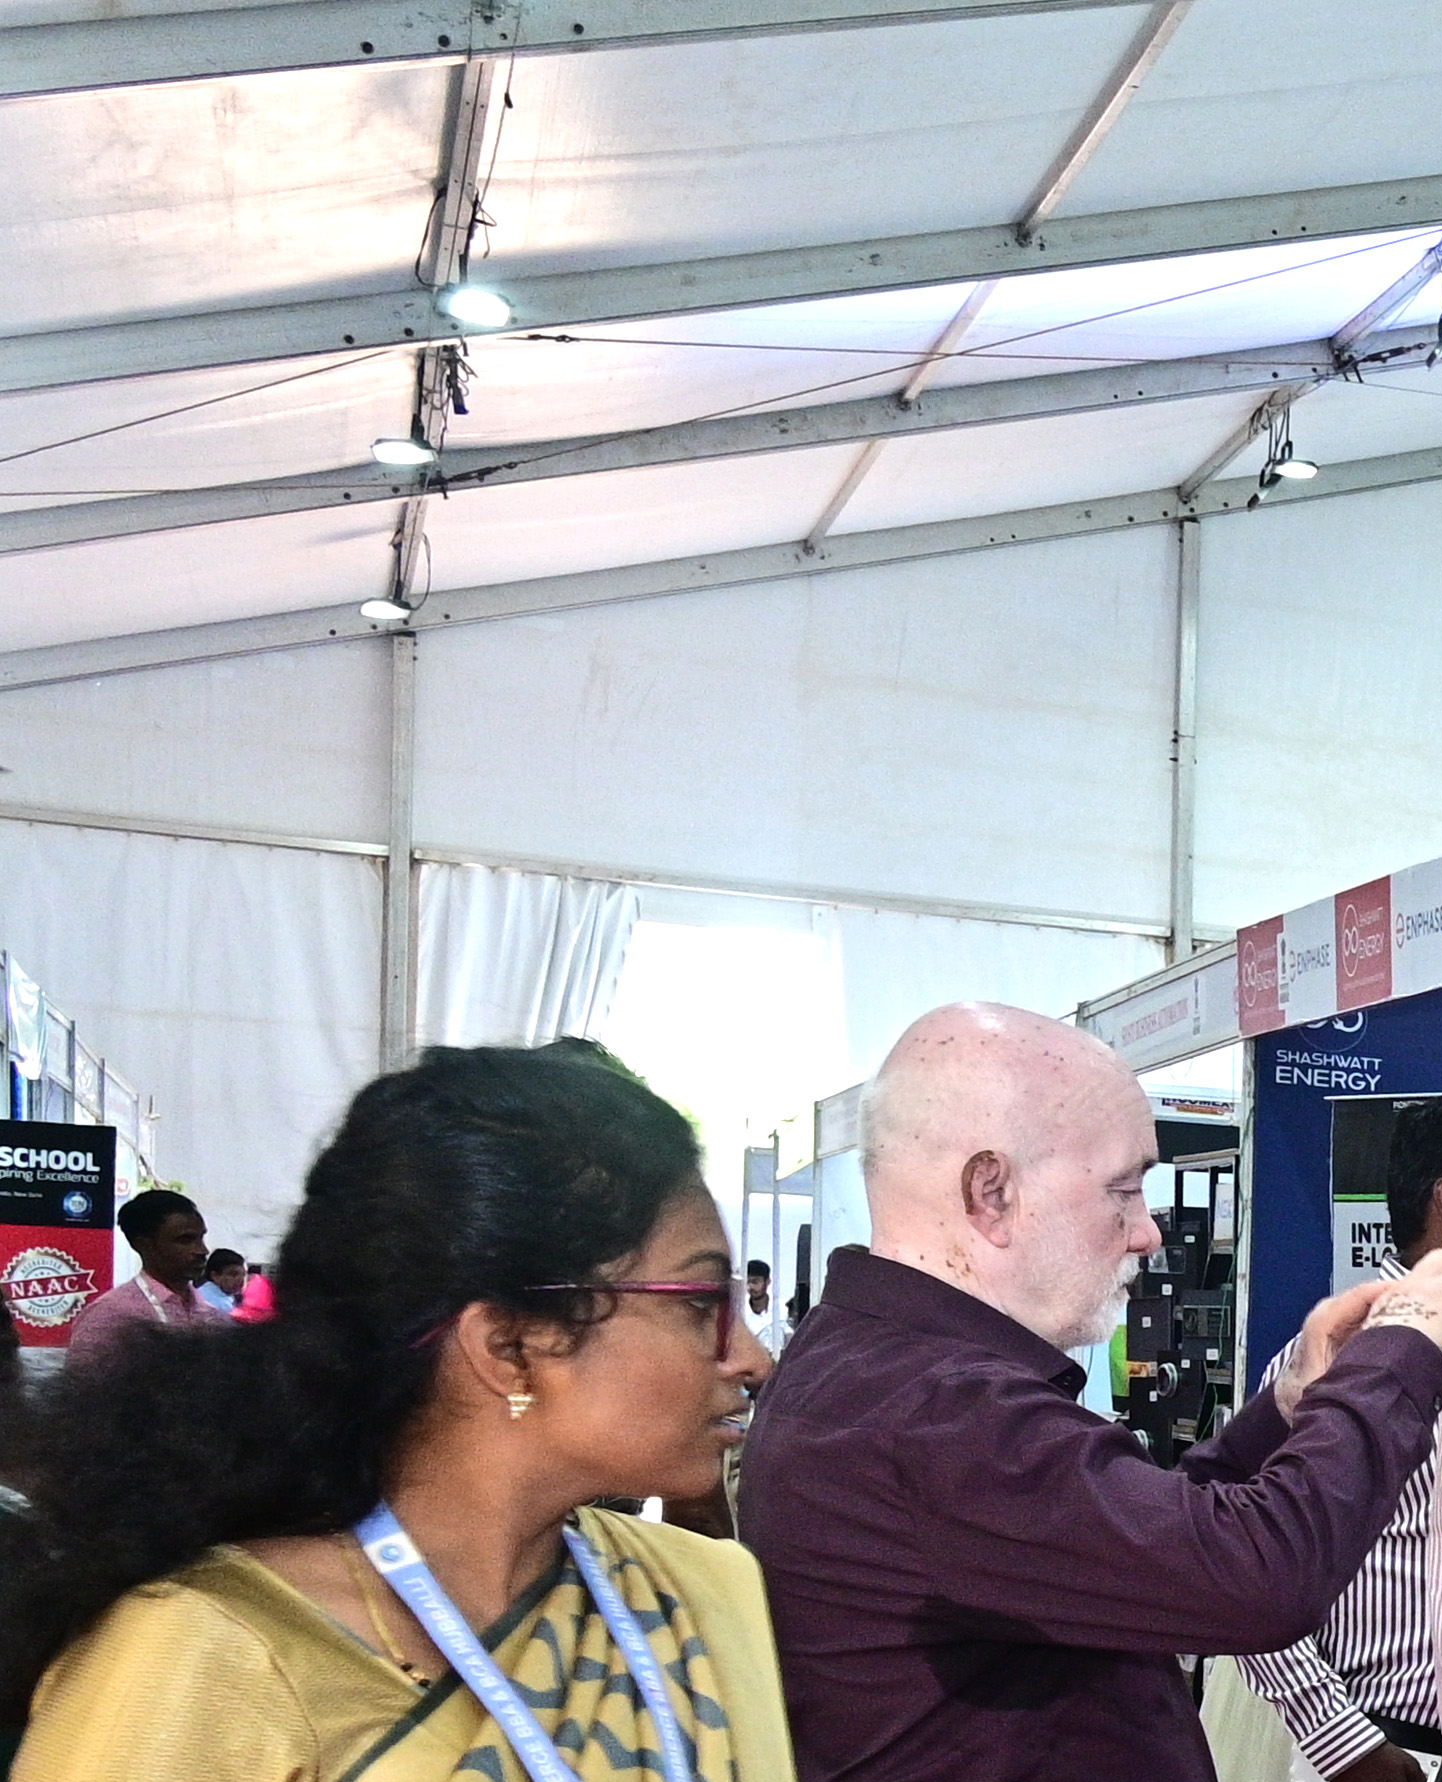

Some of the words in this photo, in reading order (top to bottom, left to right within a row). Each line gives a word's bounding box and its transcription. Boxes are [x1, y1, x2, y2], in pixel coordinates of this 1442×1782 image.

[1358, 932, 1385, 959] ENERGY
[1296, 944, 1331, 975] ENPHASE
[1276, 1049, 1382, 1071] SHASHWATT
[1276, 1066, 1381, 1092] ENERGY
[0, 1147, 100, 1172] SCHOOL
[37, 1169, 99, 1184] Excellence
[11, 1276, 79, 1298] NAAC
[402, 1576, 476, 1657] HUBBALLI
[467, 1653, 503, 1691] BCA
[498, 1697, 516, 1715] &
[504, 1706, 535, 1740] BBA
